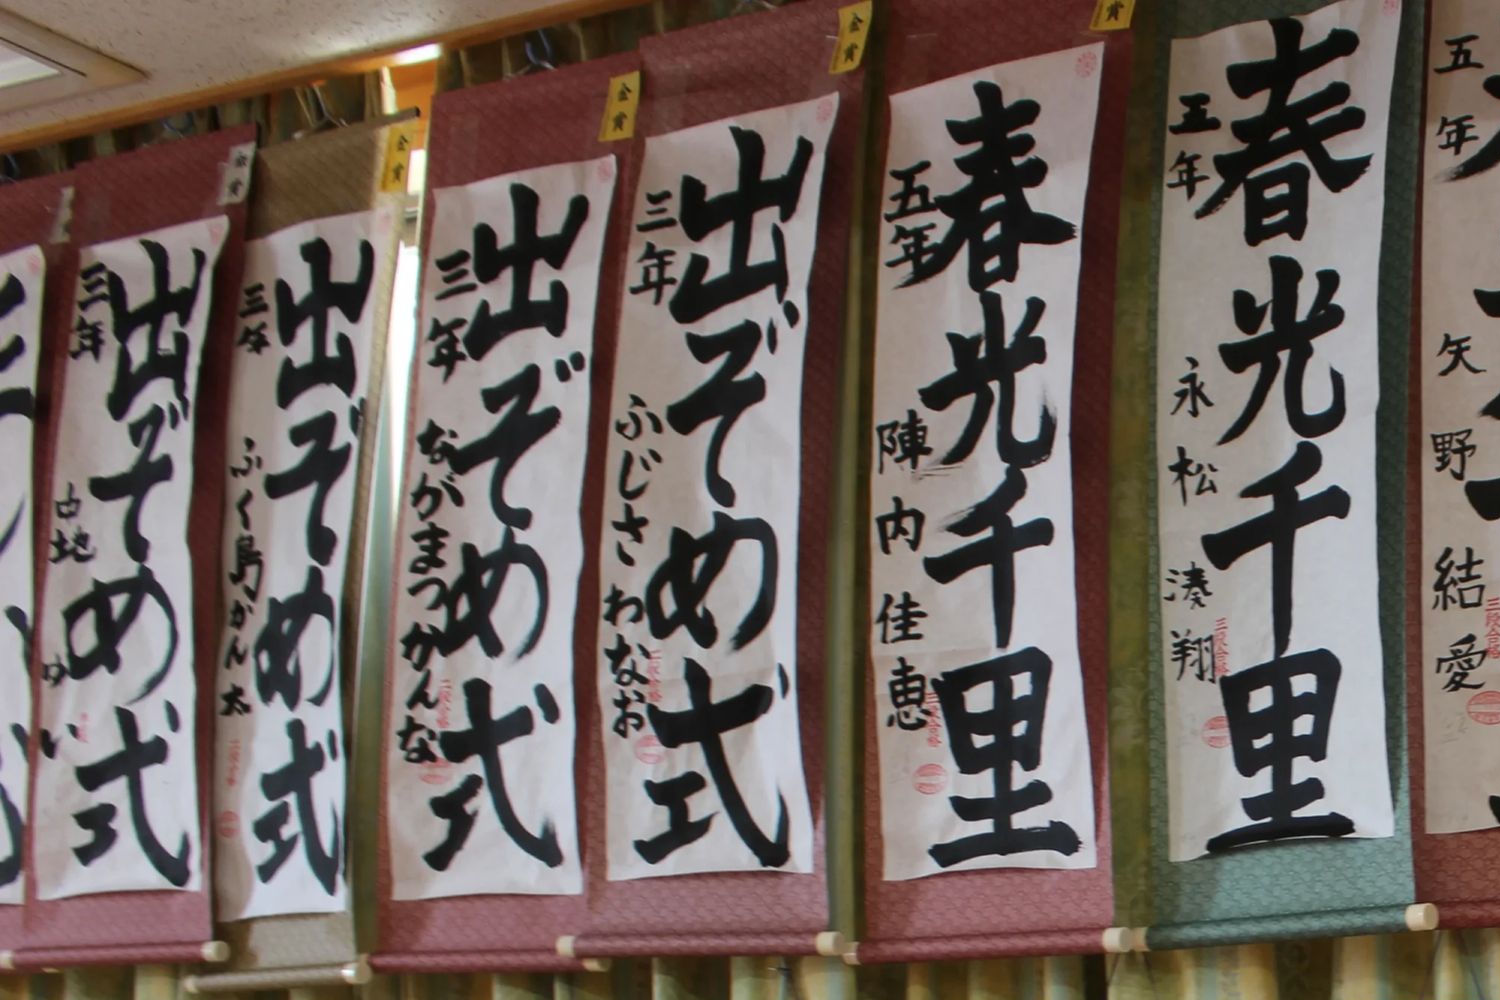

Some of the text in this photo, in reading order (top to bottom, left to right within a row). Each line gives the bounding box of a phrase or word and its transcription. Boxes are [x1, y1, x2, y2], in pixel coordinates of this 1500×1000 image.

[69, 262, 110, 362] 三年
[425, 250, 478, 383] 三年
[628, 190, 680, 307] 三年
[883, 160, 943, 292] 五年
[1166, 93, 1223, 197] 五年
[1201, 17, 1373, 854] 春光千里
[1430, 34, 1488, 694] 五年 矢野結愛
[62, 240, 205, 887] 出ぞめ式
[255, 237, 375, 893] 出ぞめ式
[424, 183, 588, 870] 出ぞめ式
[603, 393, 664, 740] ふじさわなお
[633, 126, 812, 869] 出ぞめ式
[919, 80, 1085, 869] 春光千里
